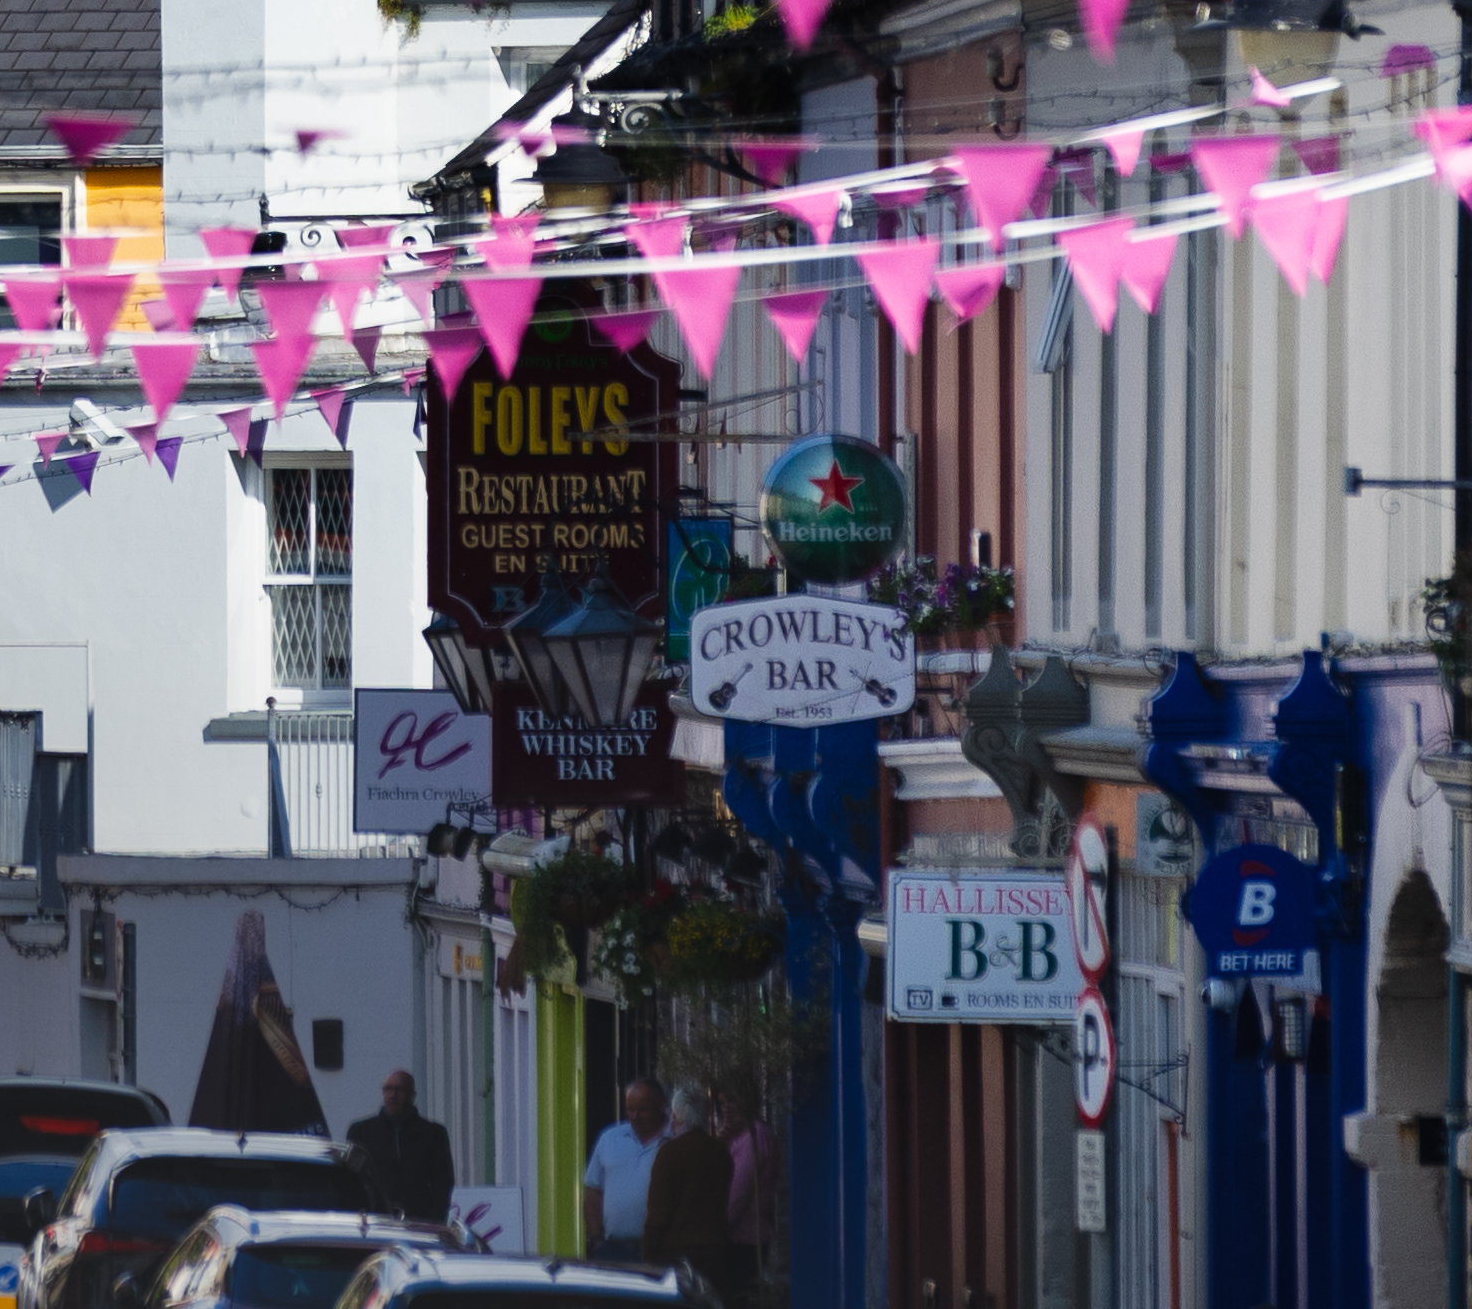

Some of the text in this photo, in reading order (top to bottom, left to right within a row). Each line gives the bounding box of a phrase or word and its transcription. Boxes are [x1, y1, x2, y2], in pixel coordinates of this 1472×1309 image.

[472, 381, 630, 456] FOLEYS
[457, 467, 646, 515] RESTAURANT
[461, 524, 545, 548] GUEST
[554, 524, 645, 548] ROOMS
[778, 521, 894, 542] Heineken
[495, 555, 526, 574] EN
[700, 610, 906, 662] CROWLEY'S
[766, 659, 841, 691] BAR
[775, 707, 832, 720] Est. 1953
[522, 734, 652, 756] WHISKEY
[557, 758, 617, 780] BAR
[367, 786, 481, 803] Fiachra Crowley
[1238, 881, 1276, 927] B
[1219, 949, 1296, 972] BET HERE
[967, 992, 1019, 1008] ROOMS
[1024, 993, 1044, 1008] EN
